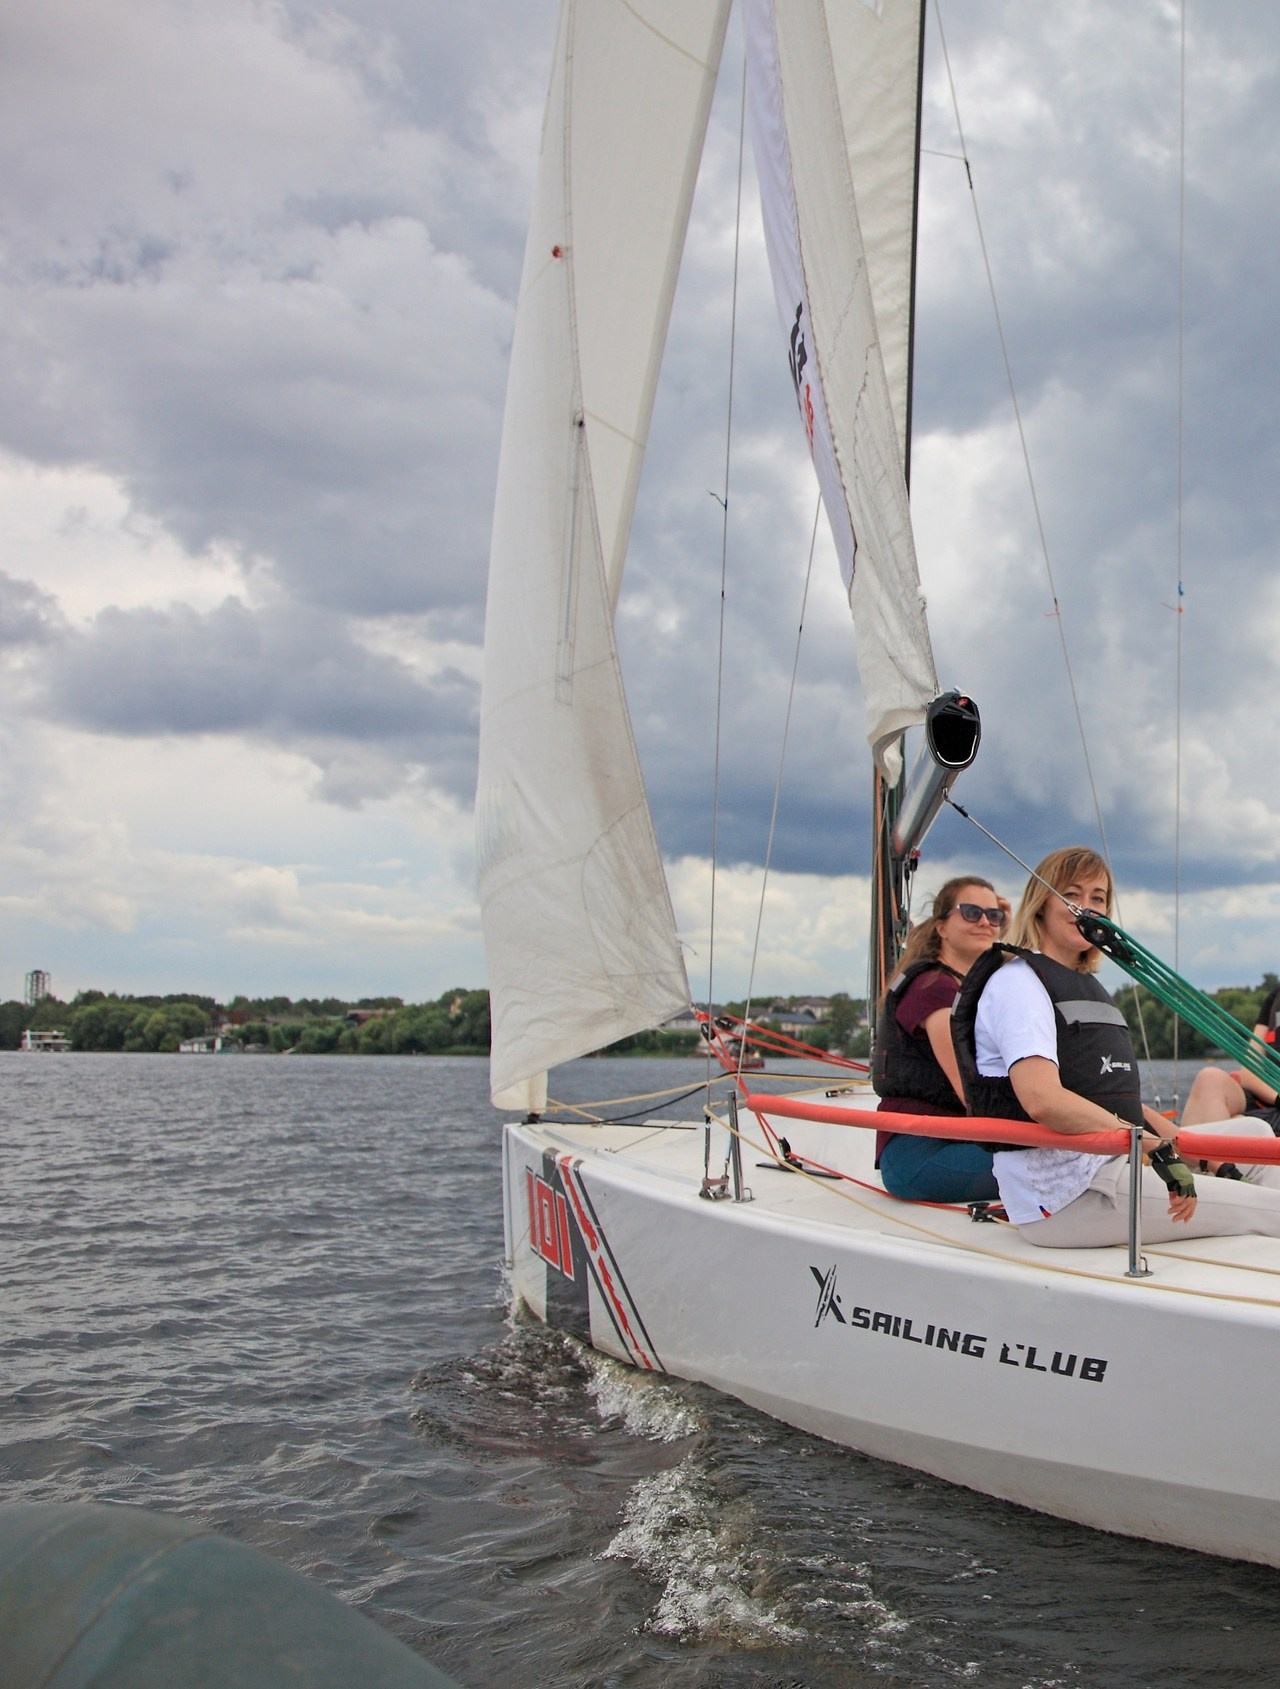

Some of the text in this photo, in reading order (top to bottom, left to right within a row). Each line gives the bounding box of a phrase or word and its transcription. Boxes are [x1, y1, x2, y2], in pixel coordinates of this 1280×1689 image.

[526, 1165, 575, 1281] 101
[851, 1306, 987, 1359] SAILING
[999, 1343, 1108, 1383] CLUB
